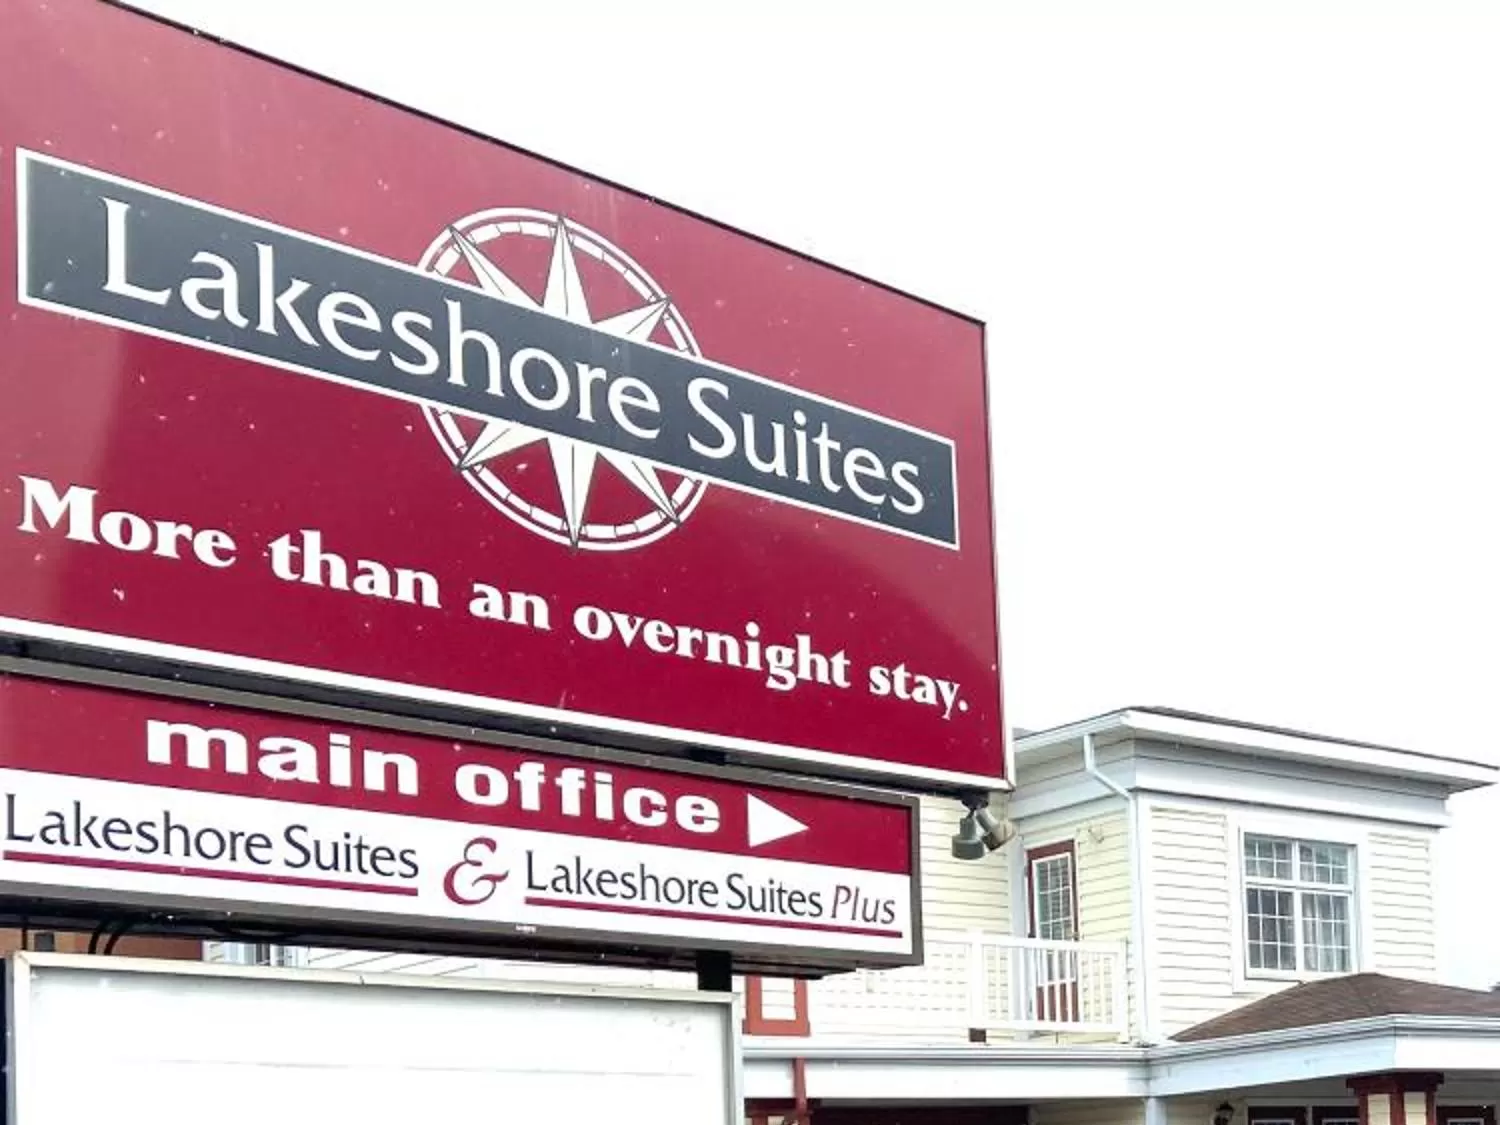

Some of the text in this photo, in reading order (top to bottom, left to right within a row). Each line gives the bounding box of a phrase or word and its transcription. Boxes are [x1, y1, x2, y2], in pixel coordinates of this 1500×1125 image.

[102, 196, 925, 515] Lakeshore Suites
[17, 474, 969, 720] More than an overnight stay.
[4, 793, 897, 925] Lakeshore Suites & Lakeshore Suites Plus
[146, 718, 720, 834] main office
